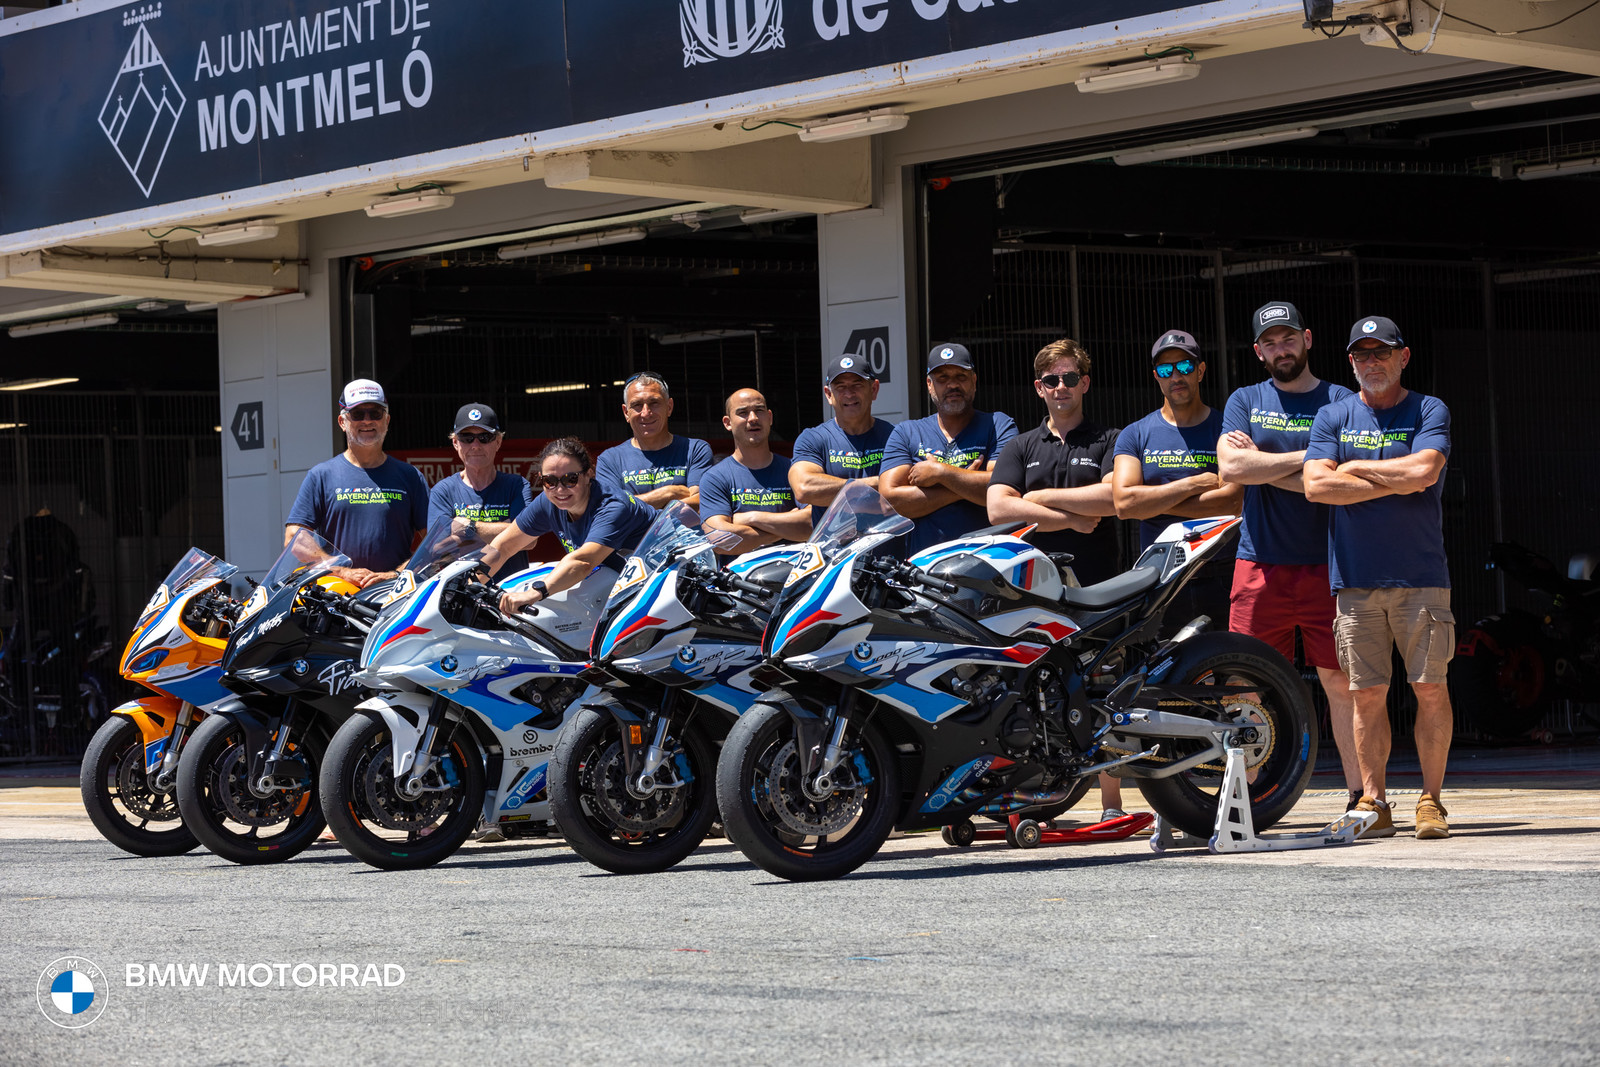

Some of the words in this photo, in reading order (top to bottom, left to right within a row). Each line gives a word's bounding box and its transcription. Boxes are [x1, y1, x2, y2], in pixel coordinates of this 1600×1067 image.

[194, 0, 381, 82] AJUNTAMENT
[391, 0, 430, 36] DE
[197, 35, 433, 152] MONTMELÓ
[855, 337, 887, 374] 40
[238, 410, 260, 442] 41
[1249, 415, 1287, 427] BAYERN
[1287, 419, 1313, 428] AVEN
[1340, 434, 1378, 445] BAYERN
[829, 455, 862, 465] BAYERN
[862, 452, 884, 464] AVEN
[1145, 455, 1182, 464] BAYERN
[624, 473, 654, 484] BAYERN
[655, 469, 687, 481] AVENUE
[336, 492, 370, 501] BAYERN
[370, 491, 403, 501] AVENUE
[731, 493, 760, 502] BAYERN
[761, 492, 792, 502] AVENUE
[317, 658, 363, 697] Fra
[510, 744, 553, 757] brembo
[975, 760, 992, 778] GILLES
